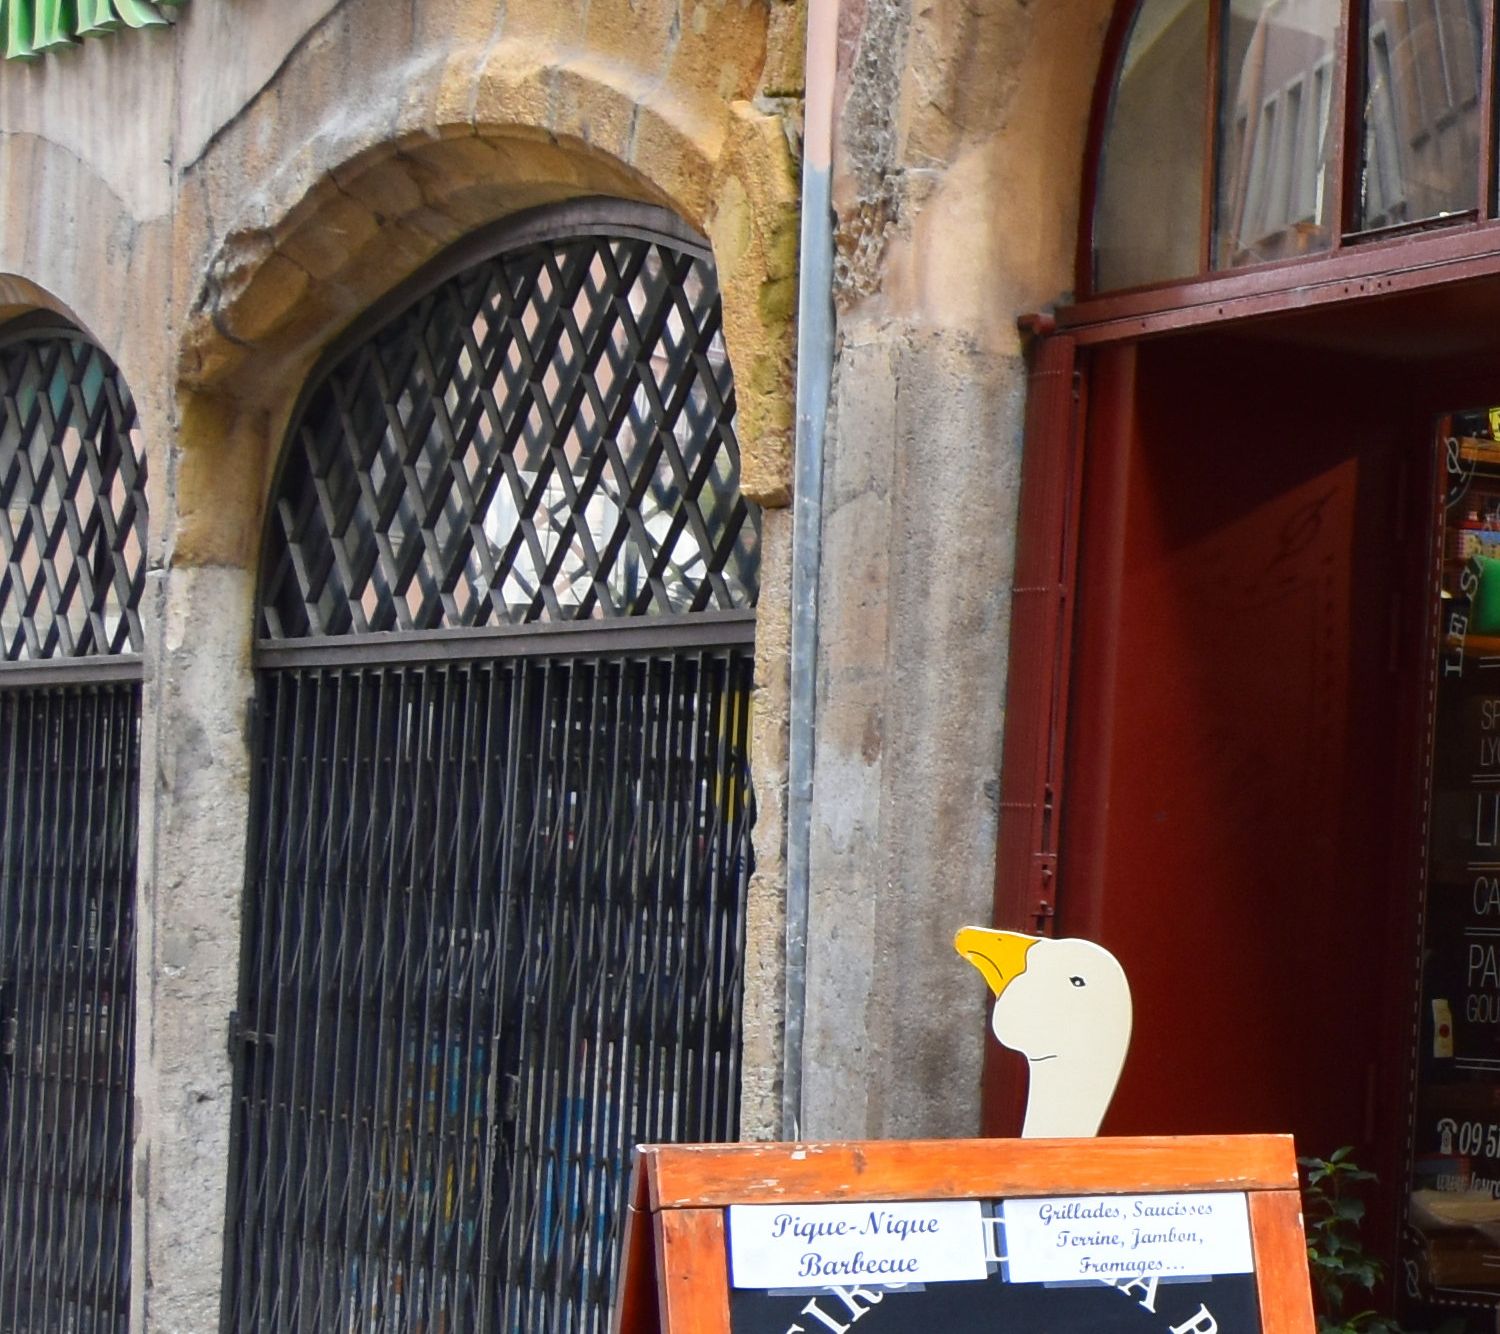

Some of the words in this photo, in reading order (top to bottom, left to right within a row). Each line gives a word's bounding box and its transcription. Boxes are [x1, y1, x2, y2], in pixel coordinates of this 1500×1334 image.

[1458, 1121, 1483, 1156] 09
[1039, 1202, 1128, 1222] Grillades,
[1133, 1200, 1213, 1218] Saucisses
[772, 1214, 940, 1244] Pique-Nique
[1056, 1230, 1126, 1249] Terrine,
[1130, 1227, 1204, 1250] Jambon,
[797, 1253, 920, 1279] Barbecue
